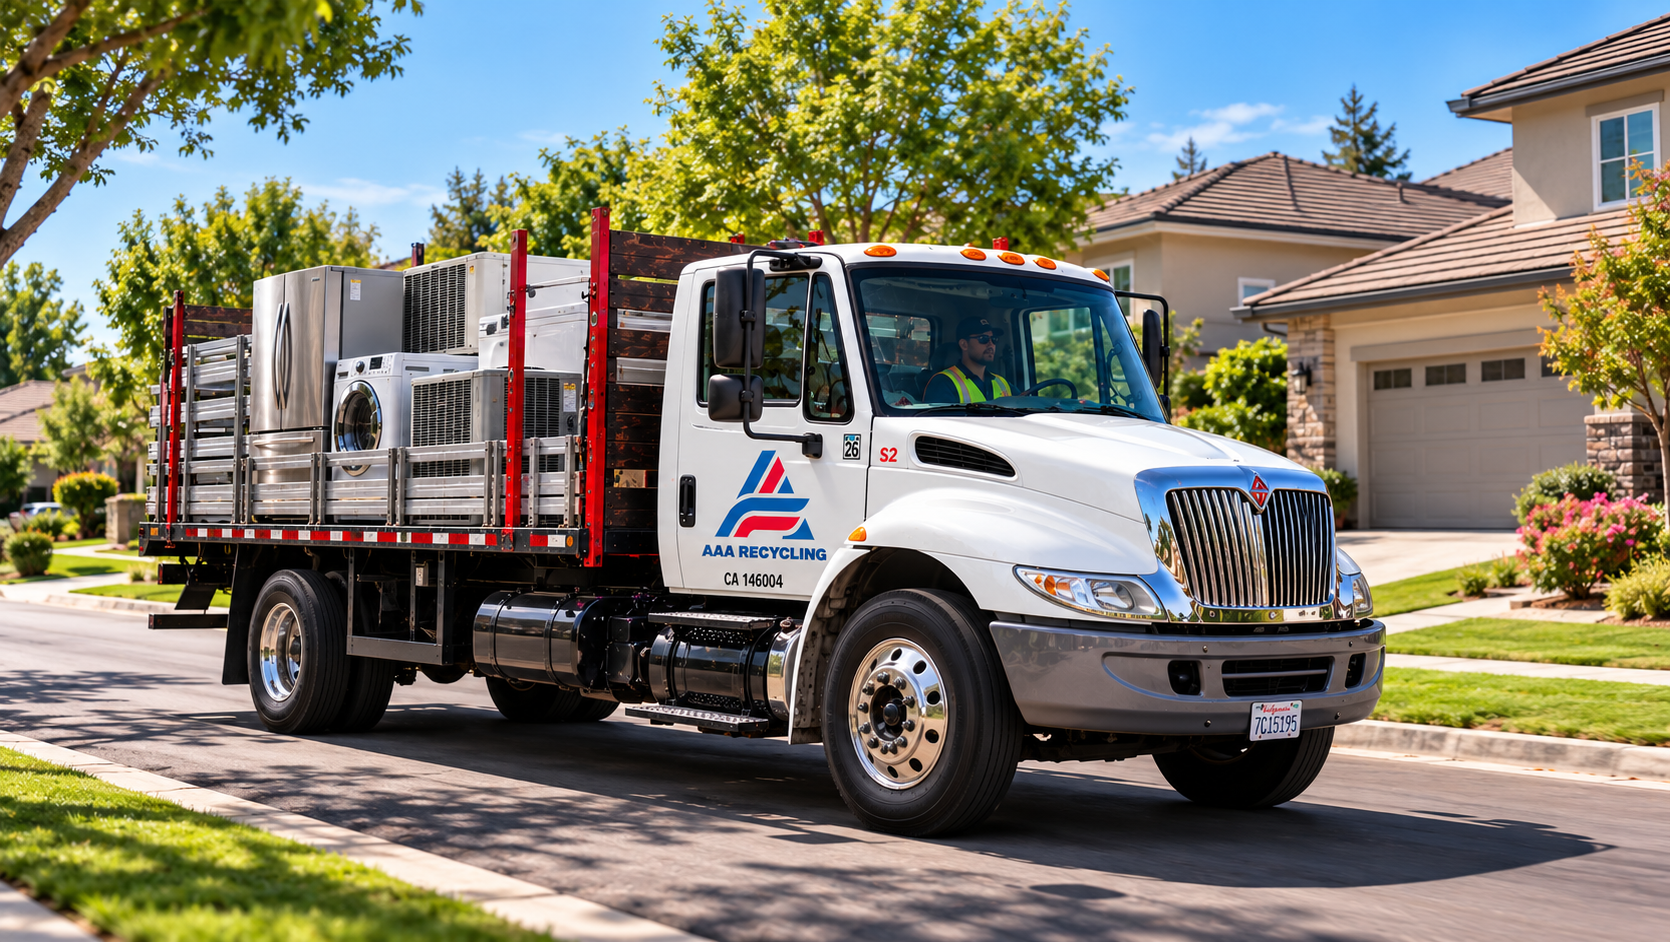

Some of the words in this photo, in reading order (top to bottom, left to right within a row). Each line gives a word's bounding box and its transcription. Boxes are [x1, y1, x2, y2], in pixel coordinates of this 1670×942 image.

[844, 441, 859, 457] 26
[879, 447, 898, 462] S2
[702, 544, 735, 558] AAA
[738, 545, 827, 561] RECYCLING
[724, 572, 739, 586] CA
[742, 573, 783, 588] 146004
[1254, 714, 1298, 735] 7C15195
